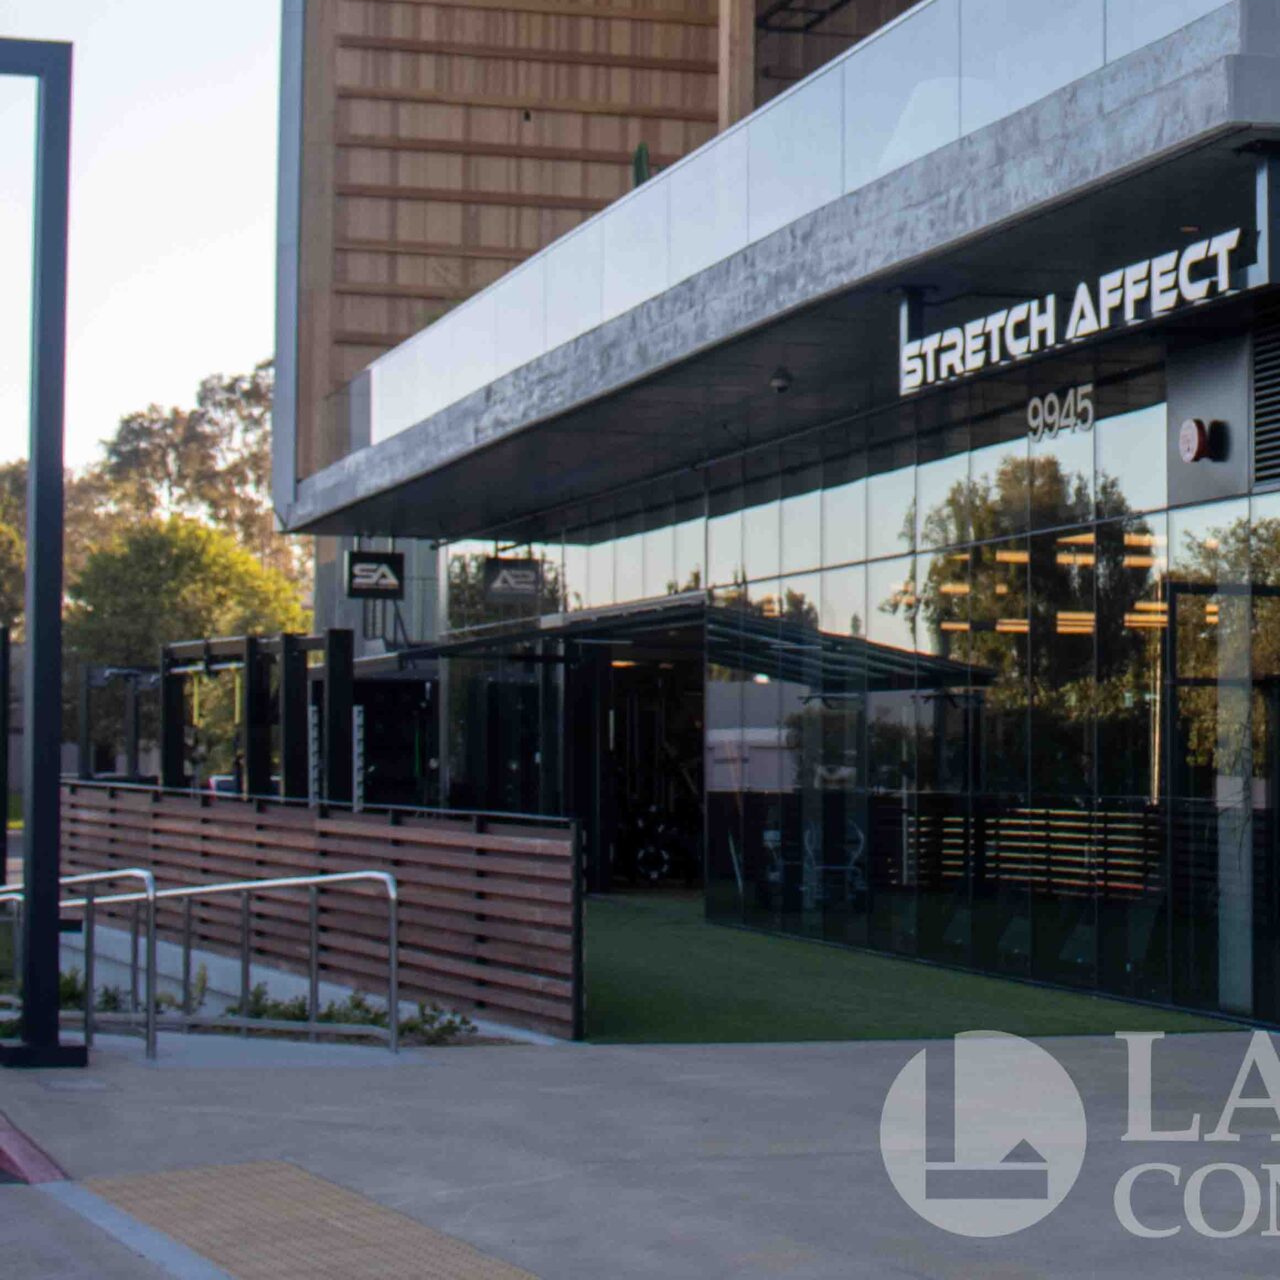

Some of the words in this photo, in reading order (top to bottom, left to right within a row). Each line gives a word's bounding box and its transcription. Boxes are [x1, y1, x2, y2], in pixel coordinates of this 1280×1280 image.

[900, 294, 1056, 396] STRETCH
[1066, 228, 1241, 340] AFFECT
[1027, 383, 1094, 442] 9945
[352, 562, 399, 584] SA
